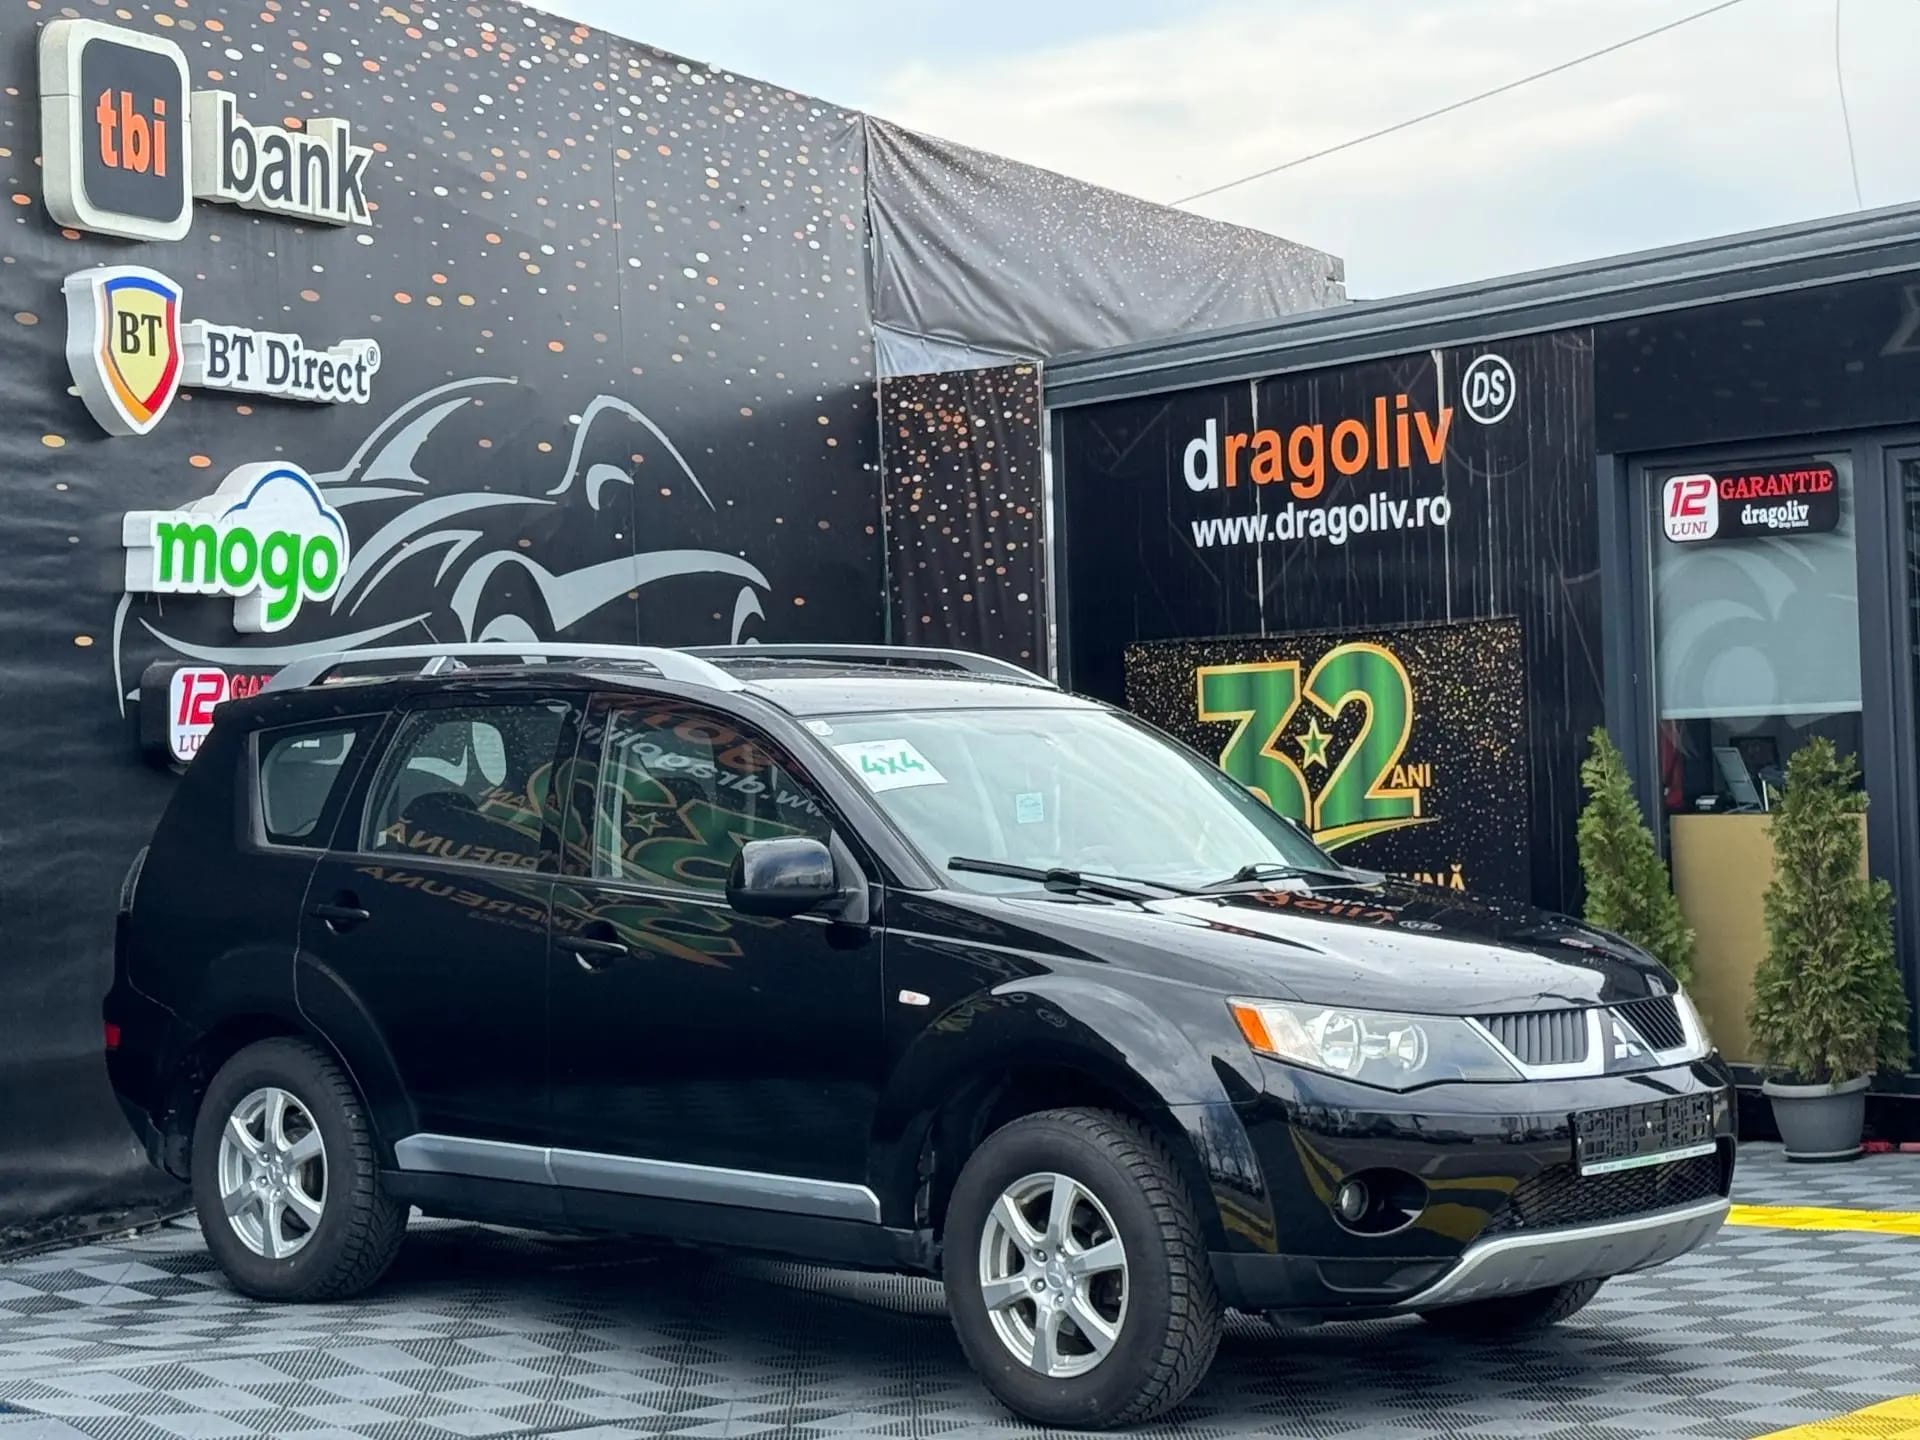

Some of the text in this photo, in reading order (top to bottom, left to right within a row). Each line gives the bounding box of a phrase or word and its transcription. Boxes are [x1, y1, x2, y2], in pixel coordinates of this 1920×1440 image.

[96, 88, 372, 217] tbi bank
[117, 311, 162, 357] BT
[207, 332, 254, 382] BT
[1472, 368, 1507, 408] DS
[1183, 394, 1454, 499] dragoliv
[1670, 479, 1711, 517] 12
[1719, 470, 1833, 500] GARANTIE
[1191, 493, 1451, 548] www.dragoliv.ro
[1671, 521, 1708, 535] LUNI
[1741, 499, 1810, 529] dragoliv
[156, 521, 339, 623] mogo
[177, 673, 225, 726] 12
[1197, 642, 1421, 833] 32
[1390, 763, 1432, 789] ANI
